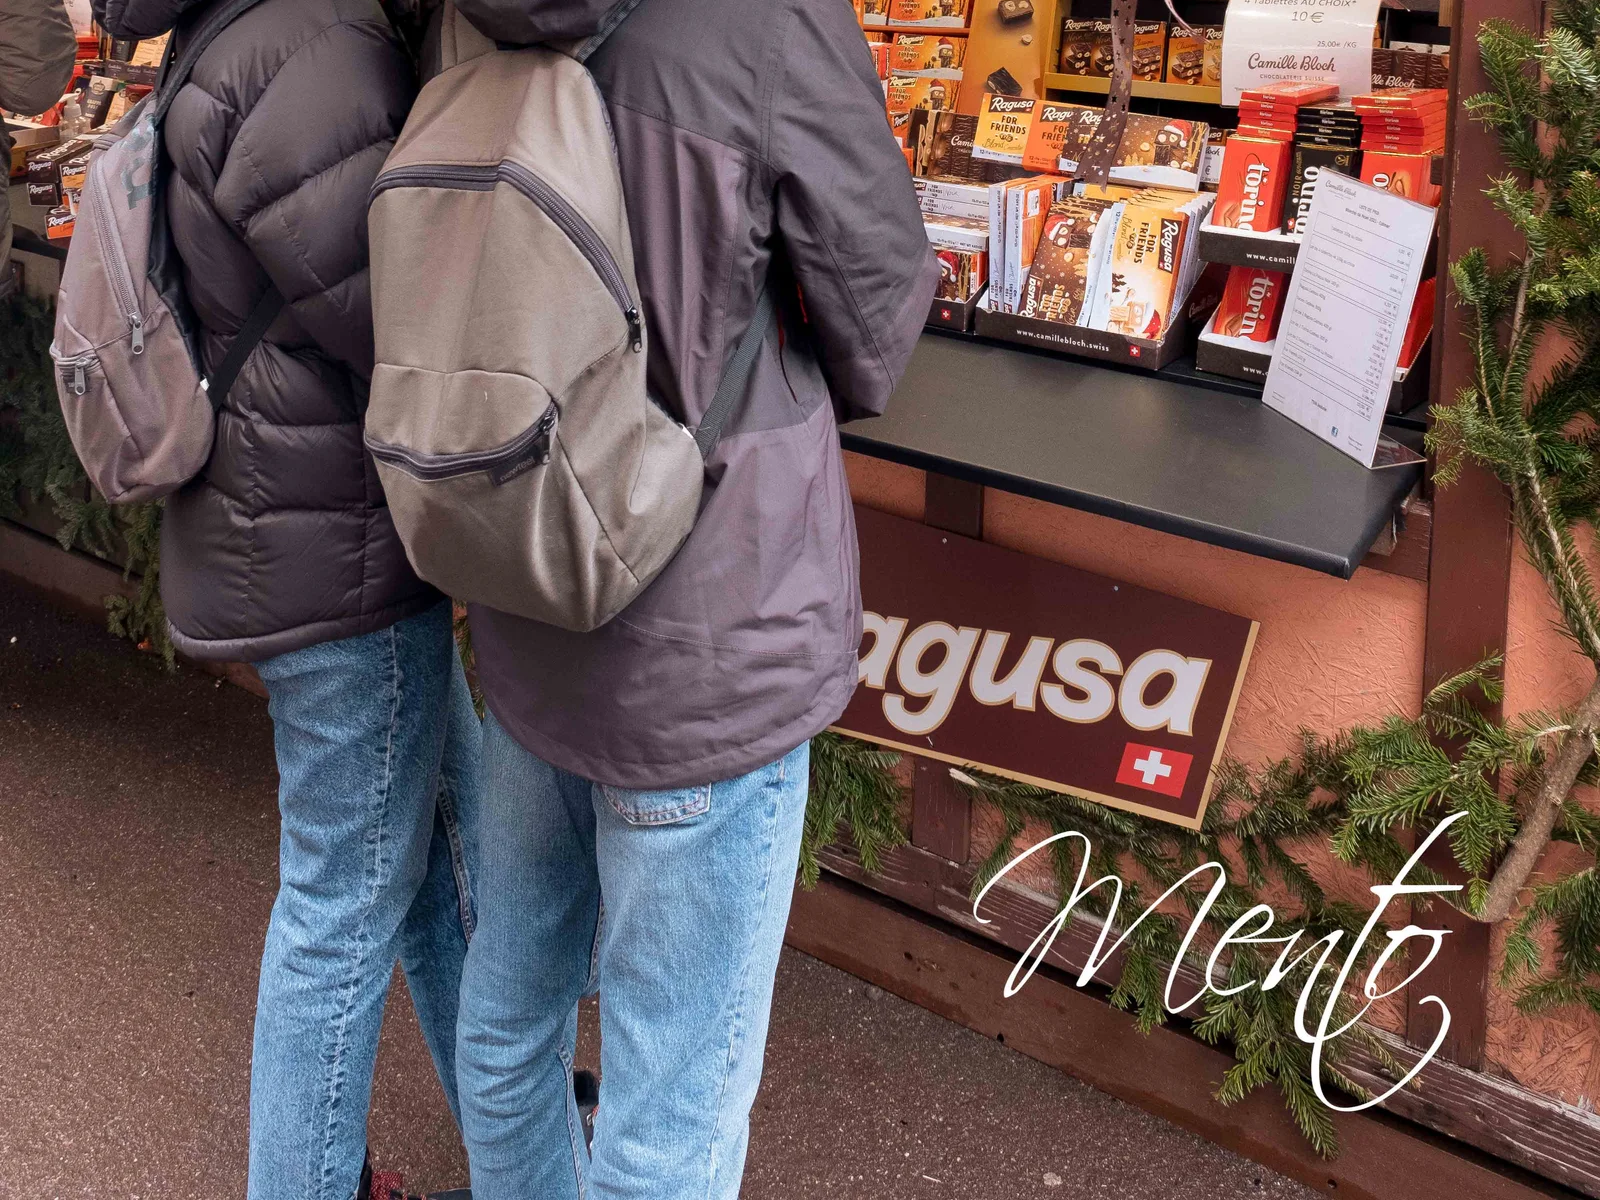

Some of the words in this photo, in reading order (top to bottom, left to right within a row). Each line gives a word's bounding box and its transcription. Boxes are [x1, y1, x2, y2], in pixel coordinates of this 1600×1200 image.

[1248, 52, 1298, 70] Camille
[1300, 55, 1336, 72] Bloch
[1385, 75, 1416, 88] Bloch
[990, 94, 1034, 112] Ragusa
[990, 122, 1027, 134] FRIENDS
[1001, 115, 1018, 124] FOR
[1205, 147, 1220, 157] loch
[28, 161, 52, 171] Ragusa
[29, 184, 53, 194] Ragusa
[1292, 176, 1302, 196] NOIR
[1134, 221, 1151, 264] FRIENDS
[1145, 234, 1157, 254] FOR
[1161, 220, 1179, 272] Ragusa
[1016, 329, 1110, 352] www.camillebloch.swiss
[858, 611, 1213, 737] agusa
